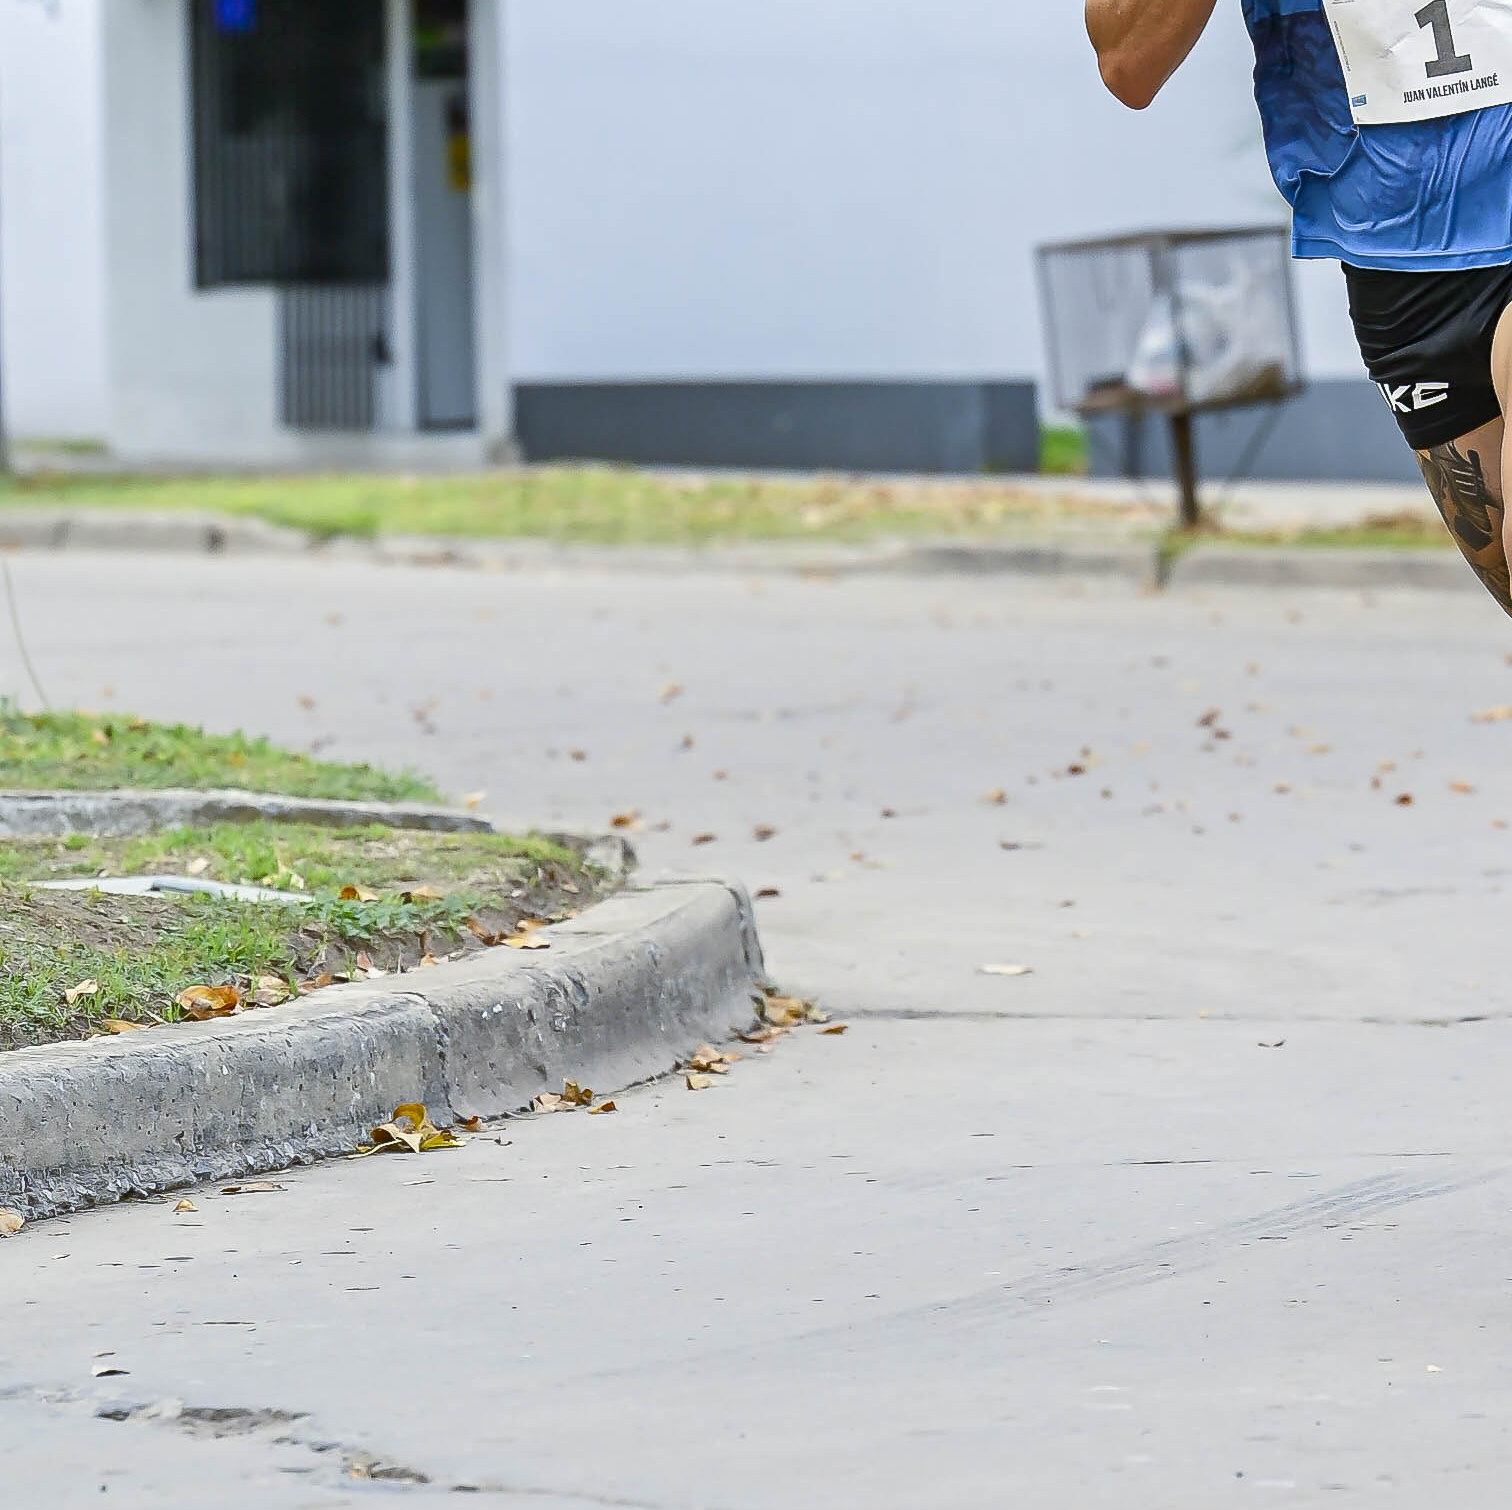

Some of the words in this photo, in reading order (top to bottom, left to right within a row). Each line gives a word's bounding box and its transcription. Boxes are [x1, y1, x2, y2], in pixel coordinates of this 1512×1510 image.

[1403, 88, 1426, 104] JUAN
[1426, 79, 1469, 99] VALENTÍN
[1470, 72, 1500, 91] LANGÉ
